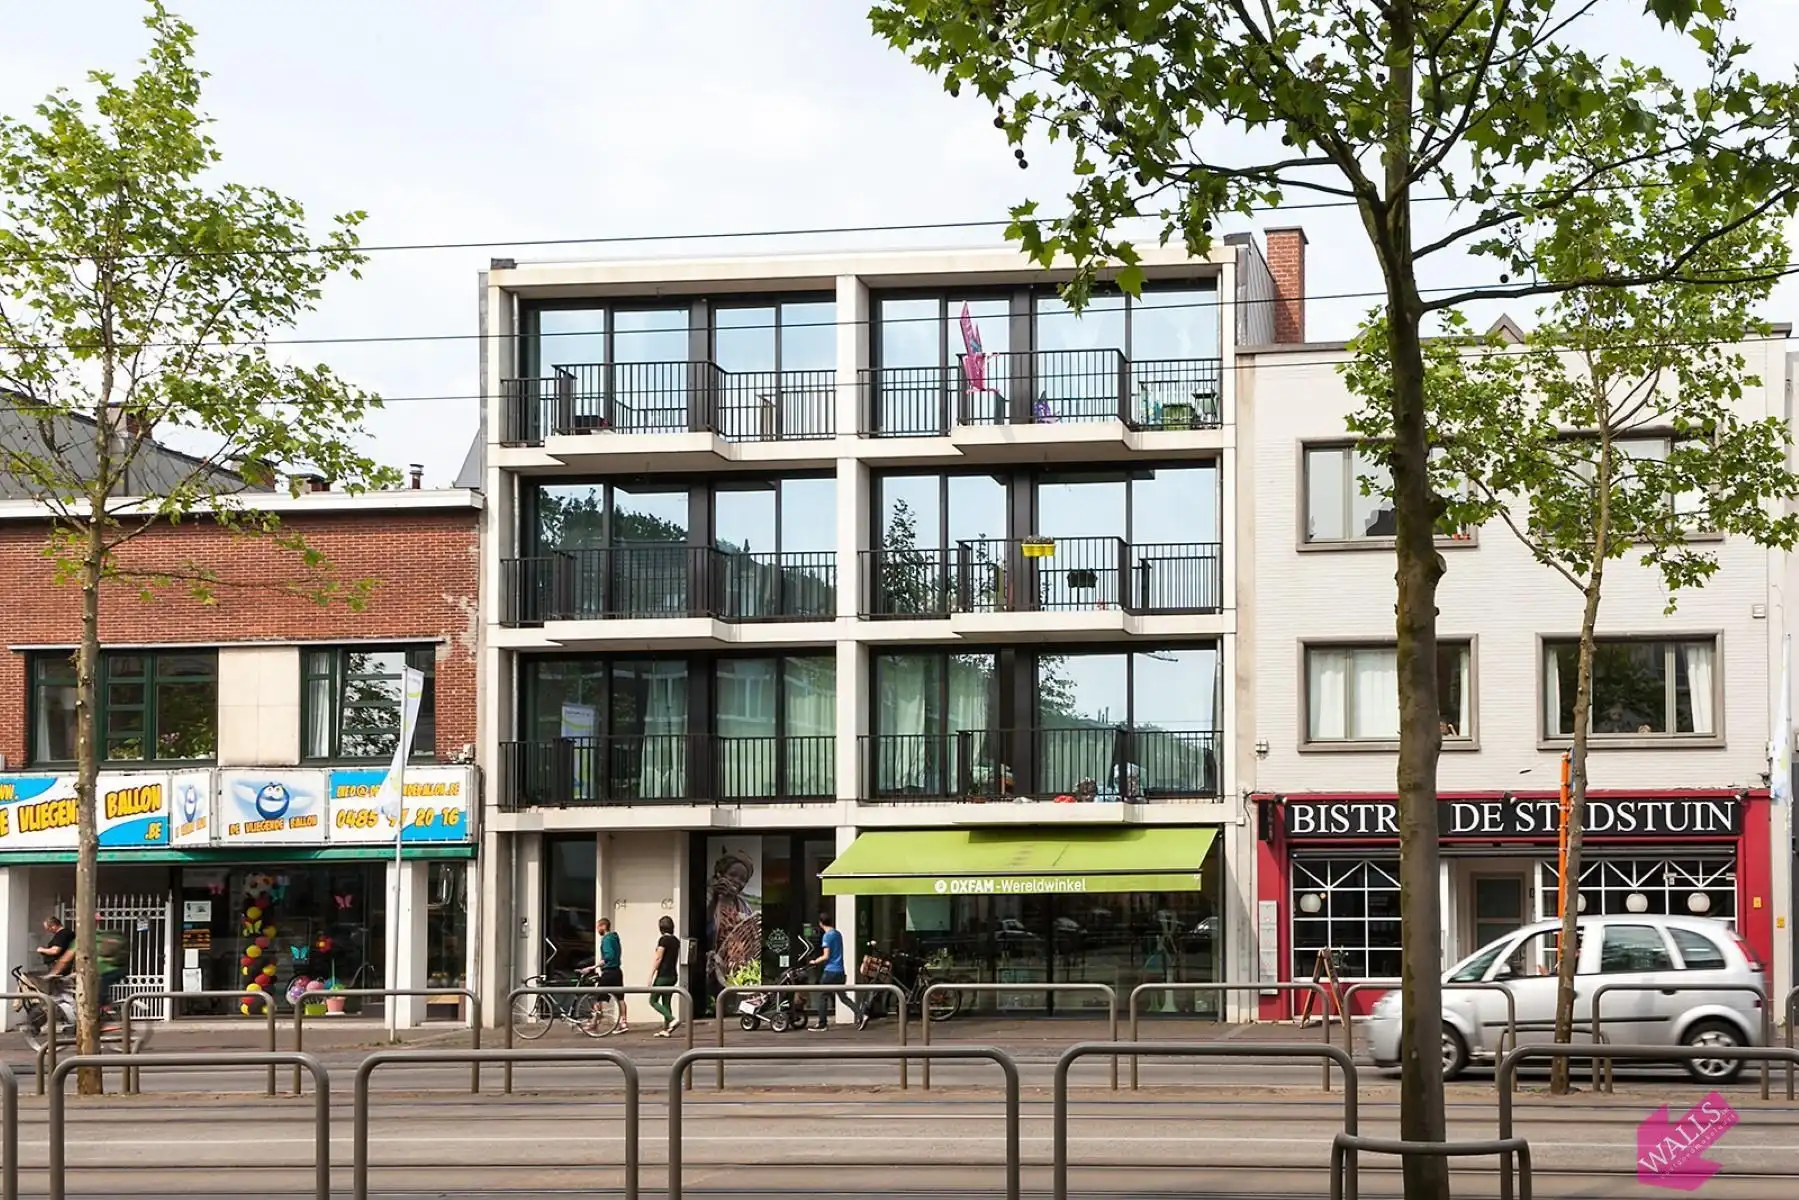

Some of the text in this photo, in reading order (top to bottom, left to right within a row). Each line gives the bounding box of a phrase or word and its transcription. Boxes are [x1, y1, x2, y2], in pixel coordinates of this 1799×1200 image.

[18, 798, 79, 833] VLIEGEN
[105, 784, 162, 819] BALLON
[289, 815, 318, 829] BALLON
[336, 809, 378, 828] 0485
[415, 808, 434, 827] 20
[441, 807, 459, 826] 16
[1291, 803, 1401, 833] BISTR
[1452, 803, 1504, 832] DE
[1515, 801, 1733, 832] STDSTUIN
[145, 822, 162, 840] .BE
[950, 879, 994, 894] OXFAM
[614, 898, 627, 910] 64
[661, 898, 674, 910] 62
